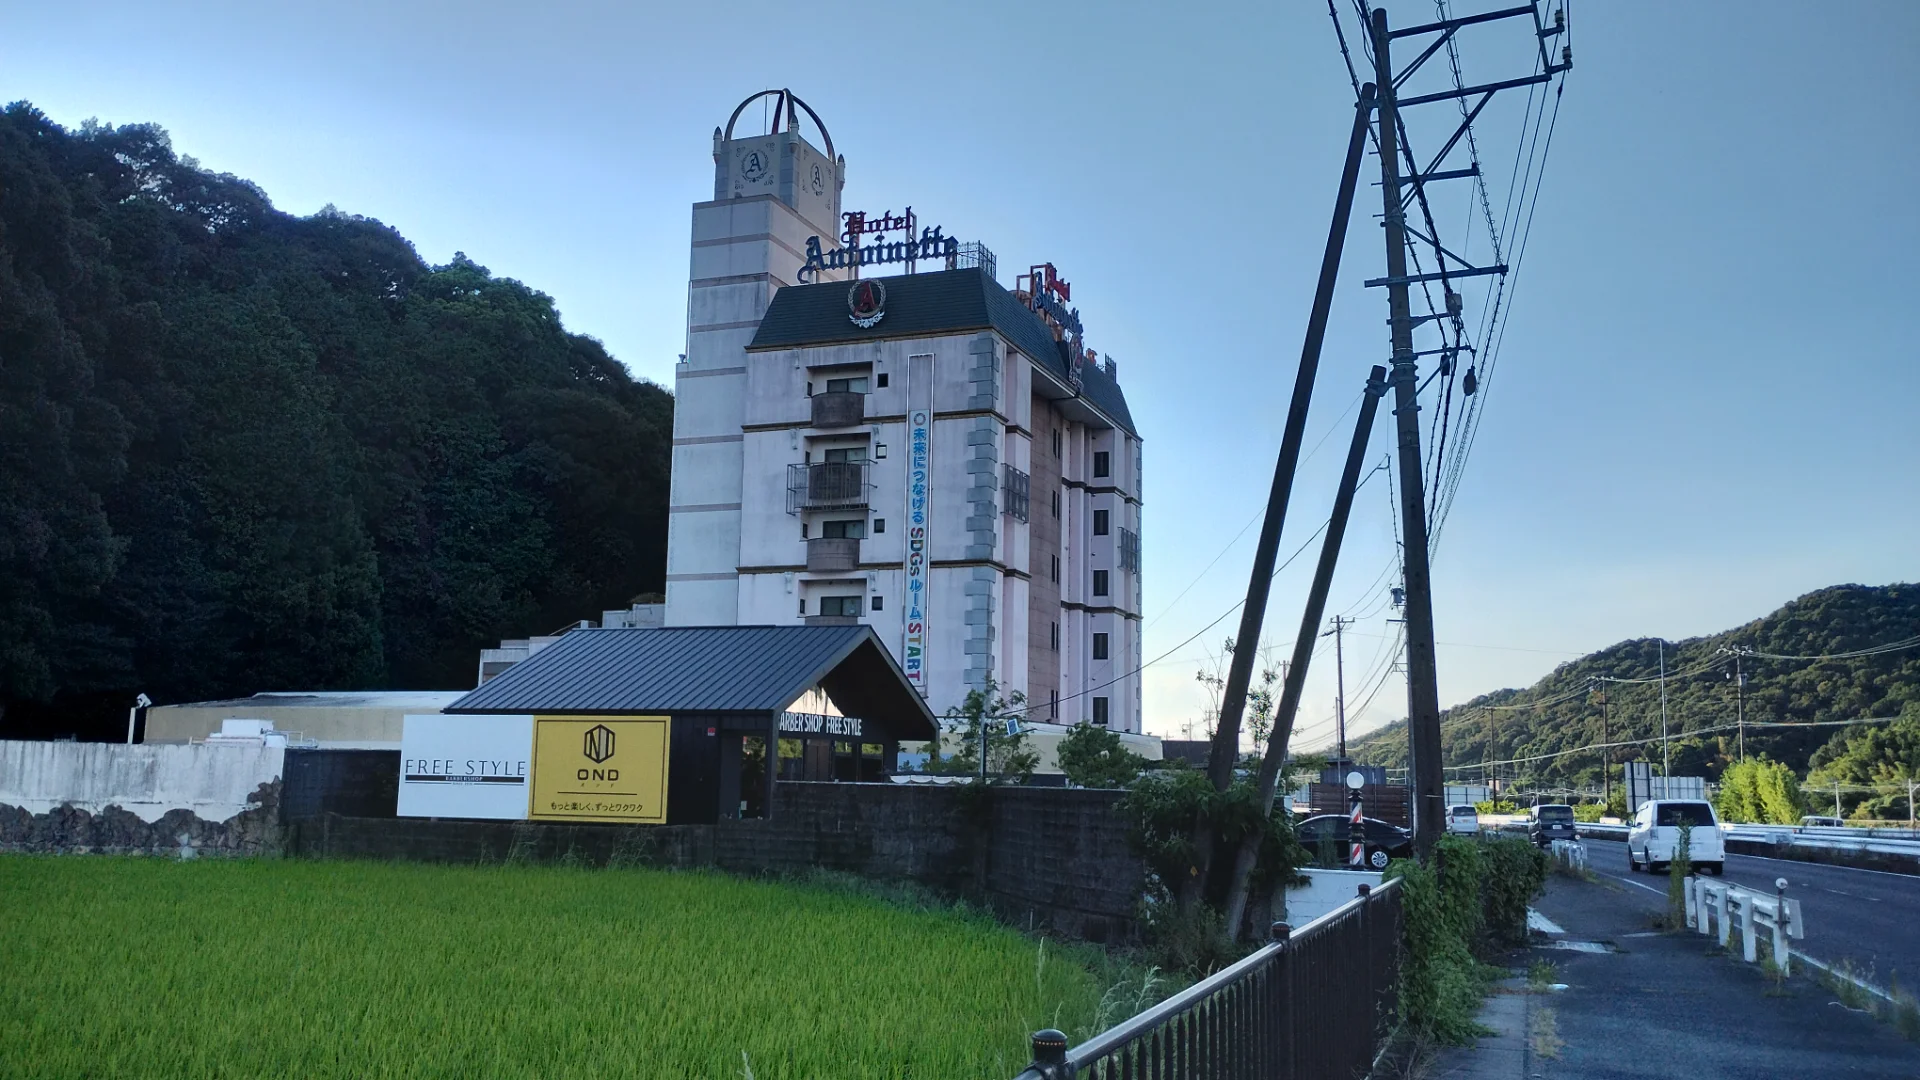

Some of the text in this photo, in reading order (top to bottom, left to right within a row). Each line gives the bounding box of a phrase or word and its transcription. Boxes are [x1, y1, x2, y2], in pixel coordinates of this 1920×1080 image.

[745, 152, 762, 180] A
[841, 206, 912, 243] Hotel
[797, 225, 959, 284] Antoinette
[804, 713, 823, 733] SHOP
[826, 716, 842, 734] FREE
[843, 717, 862, 736] STYLE
[405, 759, 526, 776] FREE STYLE
[577, 769, 619, 781] OND
